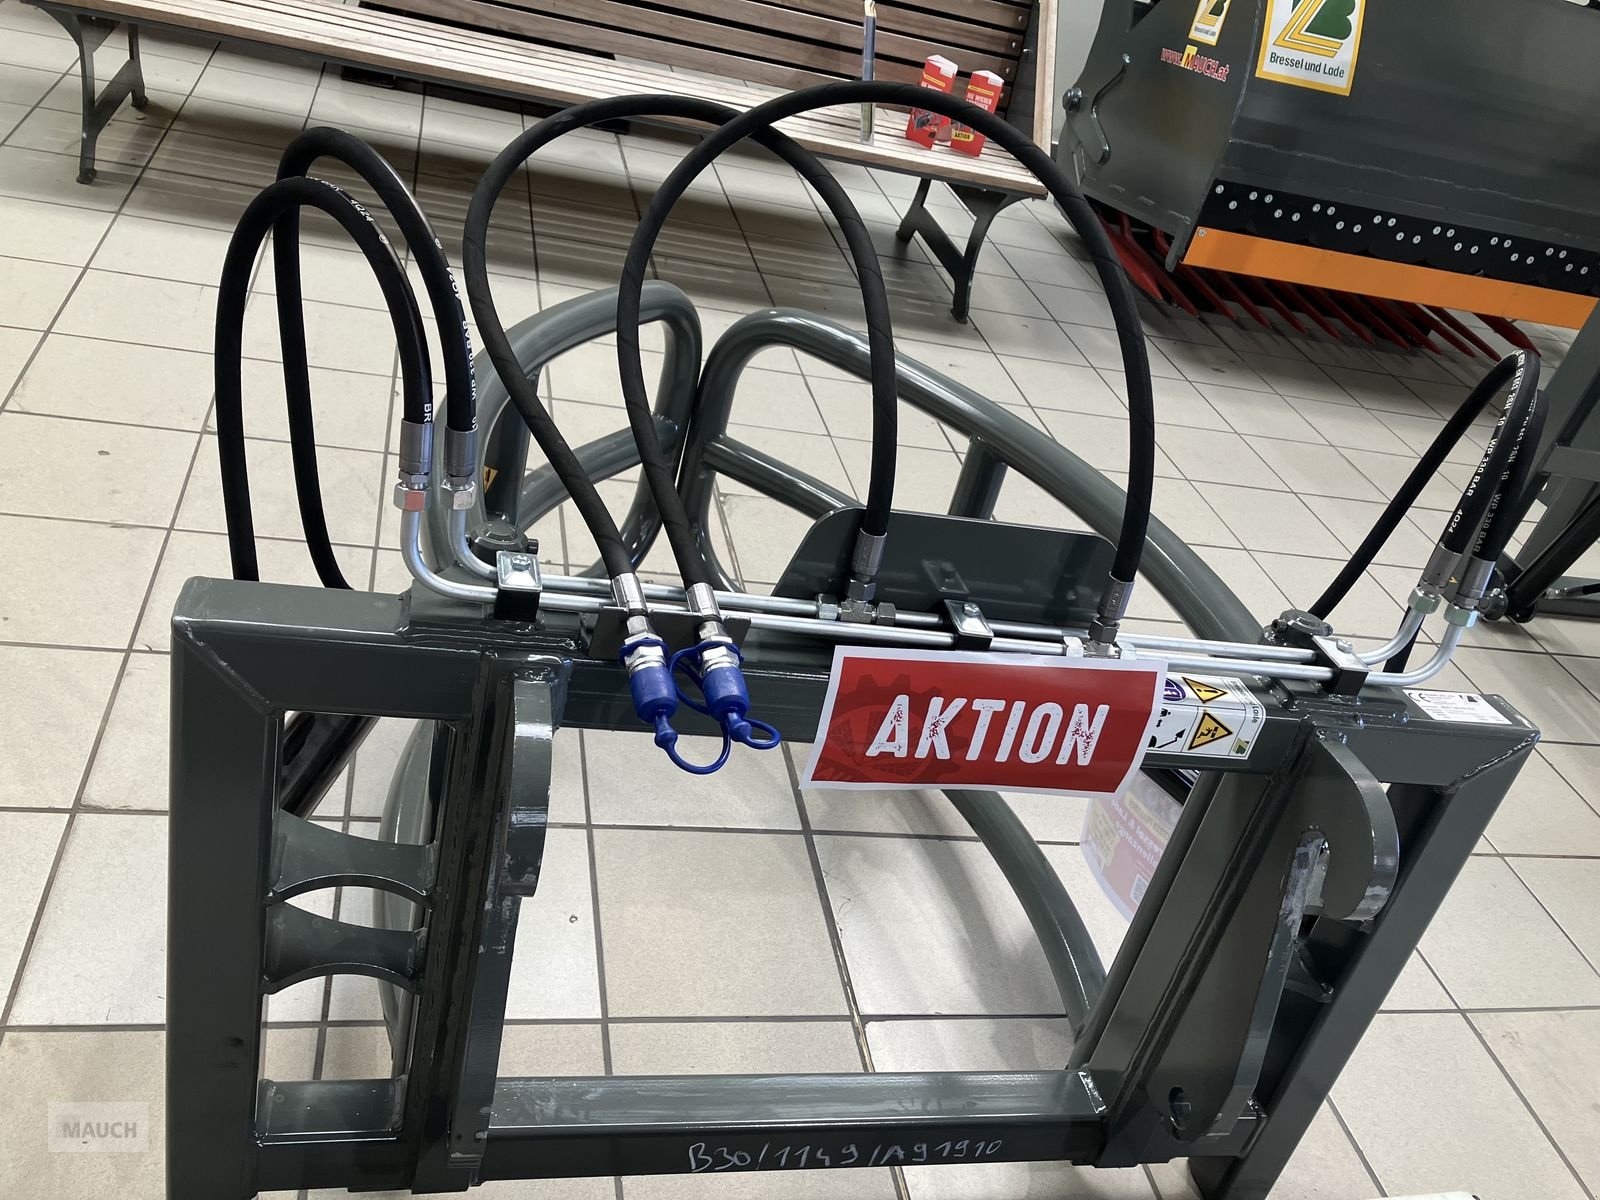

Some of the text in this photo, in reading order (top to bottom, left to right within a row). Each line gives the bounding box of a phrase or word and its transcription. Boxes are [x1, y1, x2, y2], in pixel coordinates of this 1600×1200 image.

[1160, 47, 1230, 82] www.MAUCH.at
[1269, 51, 1345, 78] Bressel und Lade
[424, 403, 433, 424] BR
[1497, 416, 1506, 426] 10
[1487, 438, 1498, 454] WP
[1477, 456, 1489, 473] 330
[1501, 470, 1510, 480] 10
[1466, 475, 1481, 497] BAR
[1491, 493, 1502, 510] WP
[1483, 512, 1494, 529] 330
[1473, 531, 1487, 553] BAR
[864, 693, 1110, 767] AKTION
